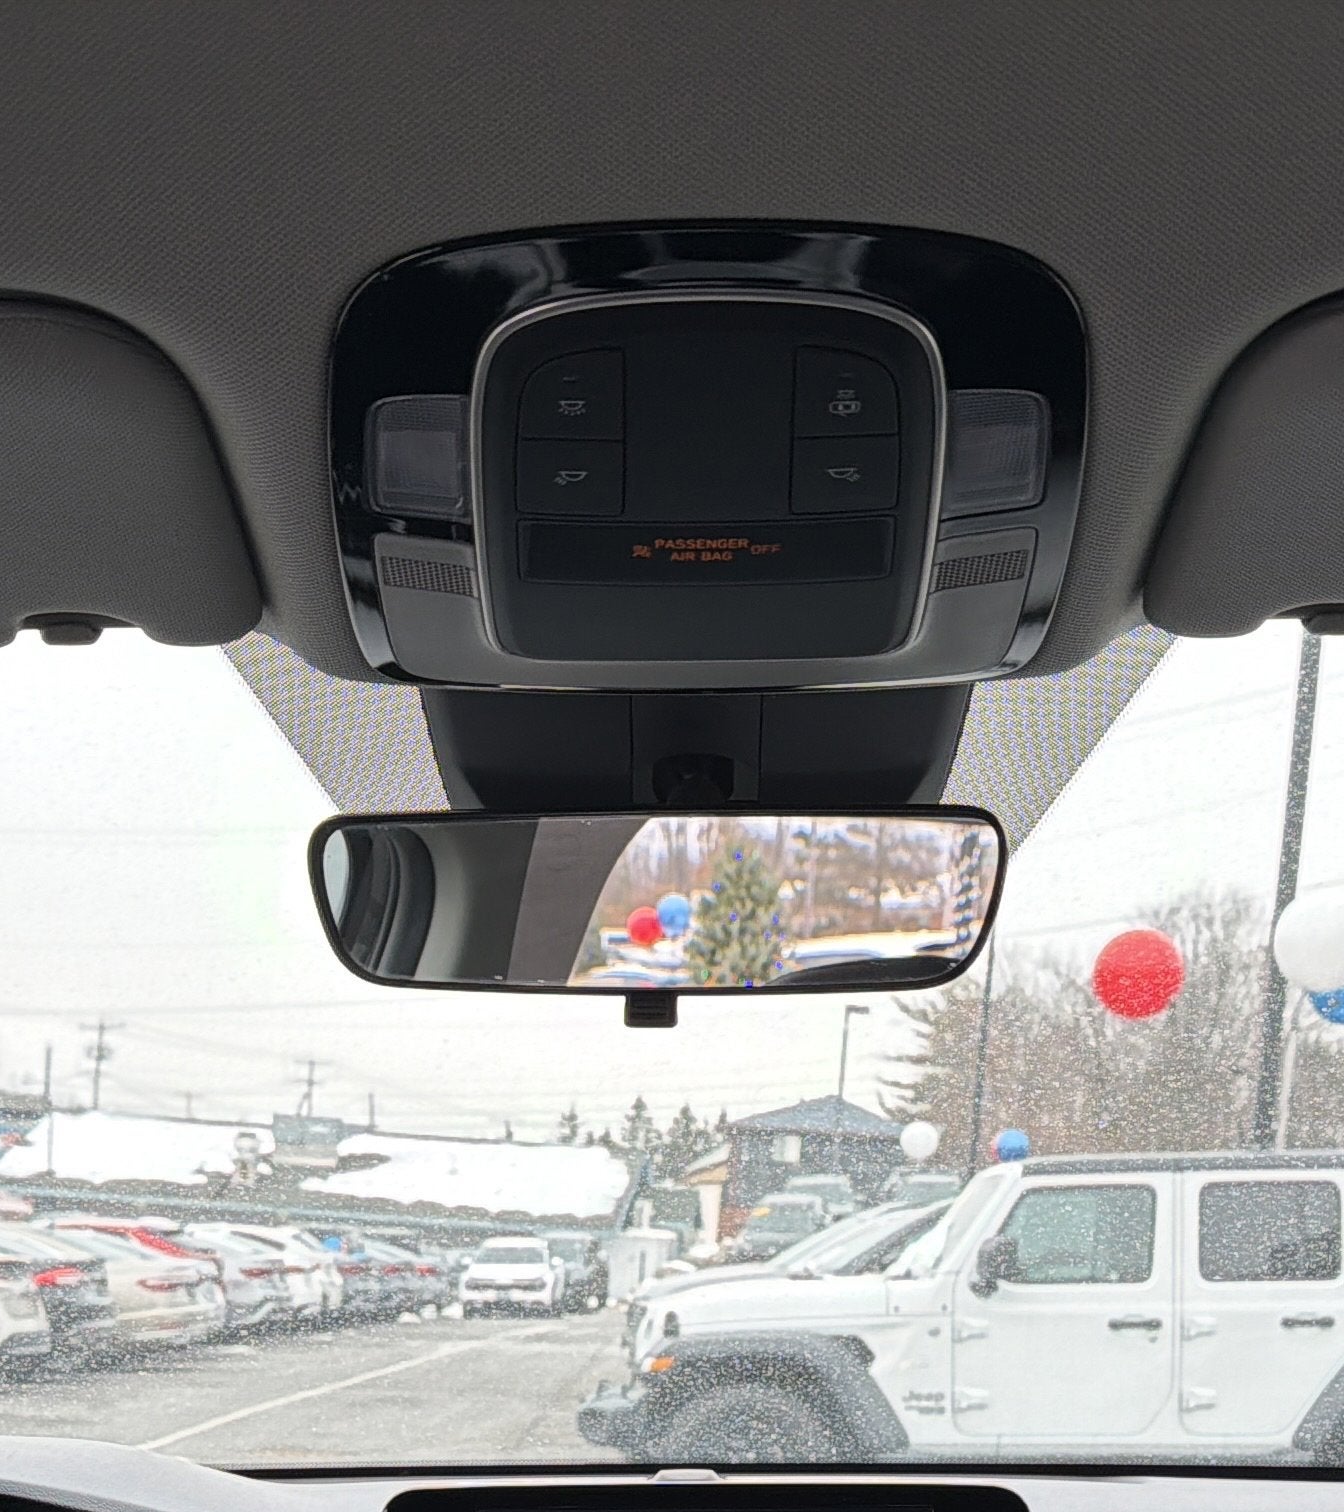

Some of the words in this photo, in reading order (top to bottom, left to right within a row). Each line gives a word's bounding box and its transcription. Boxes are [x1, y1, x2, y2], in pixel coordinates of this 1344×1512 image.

[654, 538, 749, 549] PASSENGER
[750, 544, 782, 555] OFF
[671, 551, 696, 561] AIR
[701, 551, 734, 561] BAG
